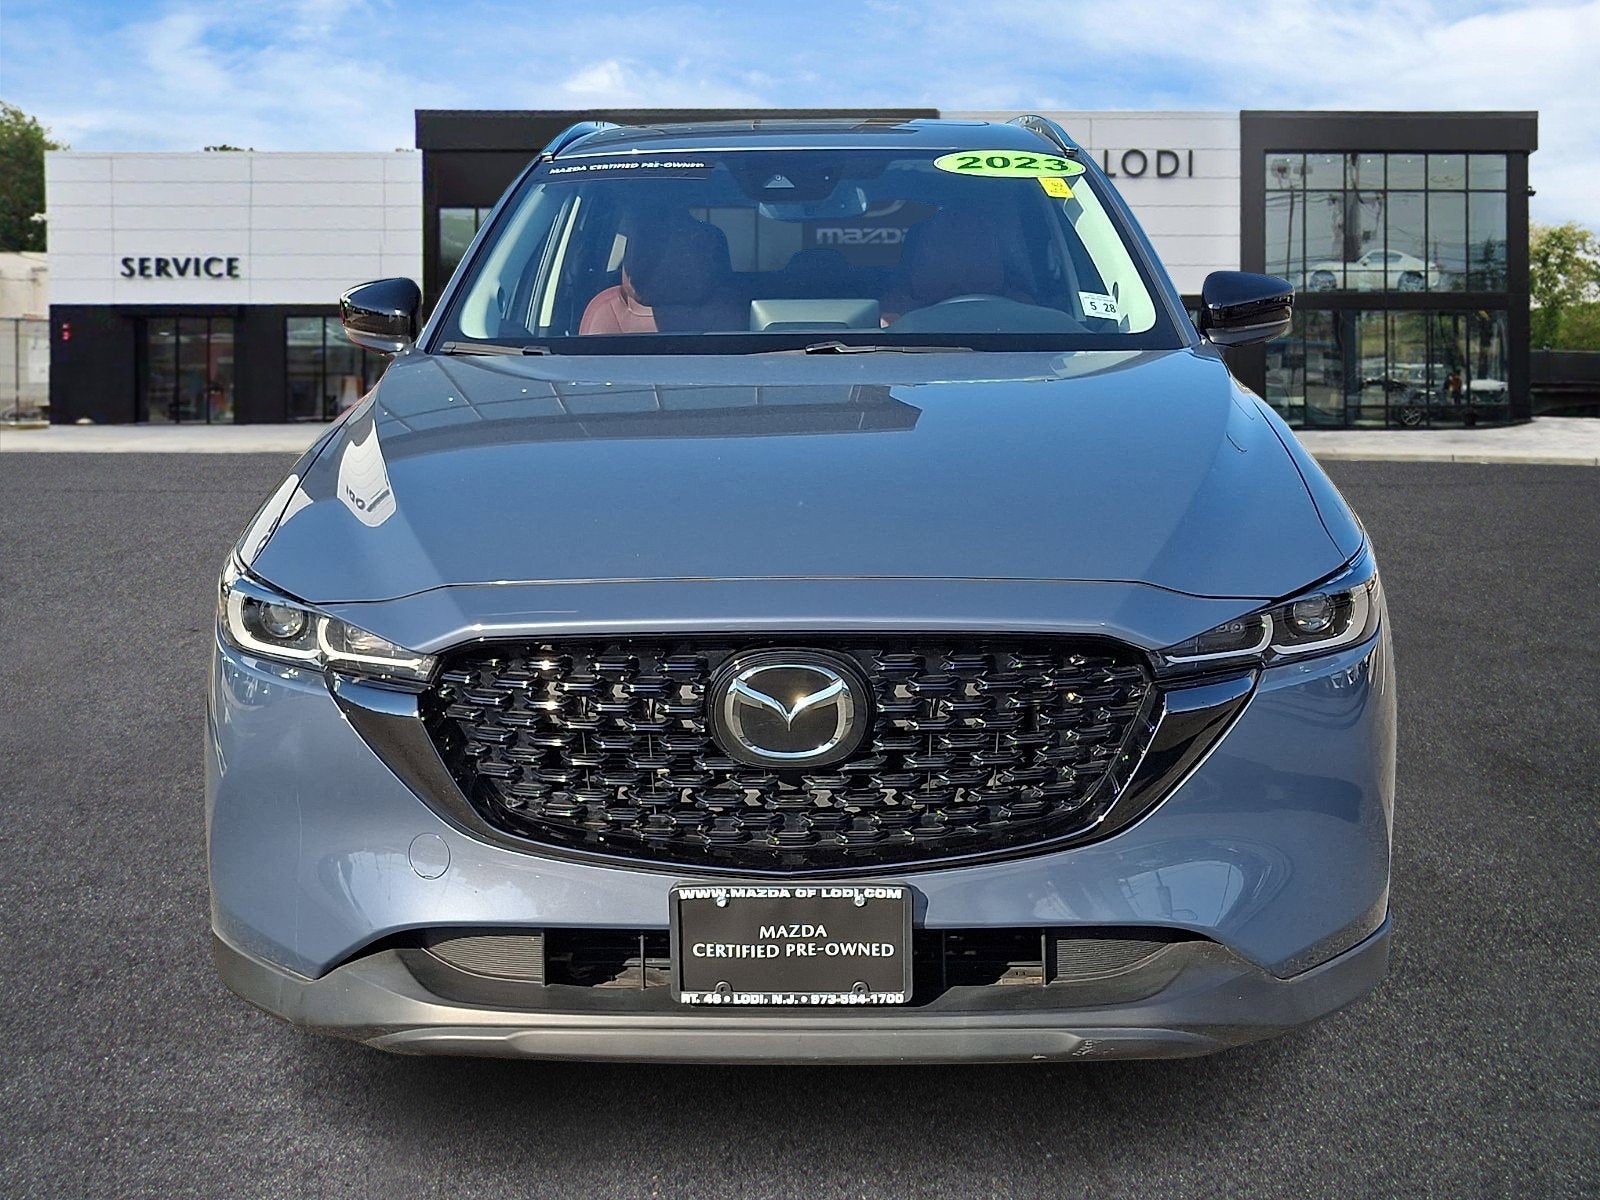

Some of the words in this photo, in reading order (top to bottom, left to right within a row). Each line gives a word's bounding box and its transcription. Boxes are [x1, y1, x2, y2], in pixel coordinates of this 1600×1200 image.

[549, 165, 587, 175] MAZDA
[589, 163, 640, 171] CERTIFIED
[641, 161, 705, 169] PRE-OWNED
[957, 156, 1069, 171] 2023
[1104, 149, 1194, 178] LODI
[120, 256, 240, 279] SERVICE
[1089, 301, 1097, 311] 5
[1102, 303, 1117, 314] 28
[678, 888, 791, 899] WWW.MAZDA
[795, 888, 817, 898] OF
[821, 888, 902, 899] LODI.COM
[759, 924, 828, 939] MAZDA
[692, 942, 780, 958] CERTIFIED
[786, 942, 895, 958] PRE-OWNED
[681, 993, 701, 1004] RT.
[772, 993, 799, 1004] N.J.
